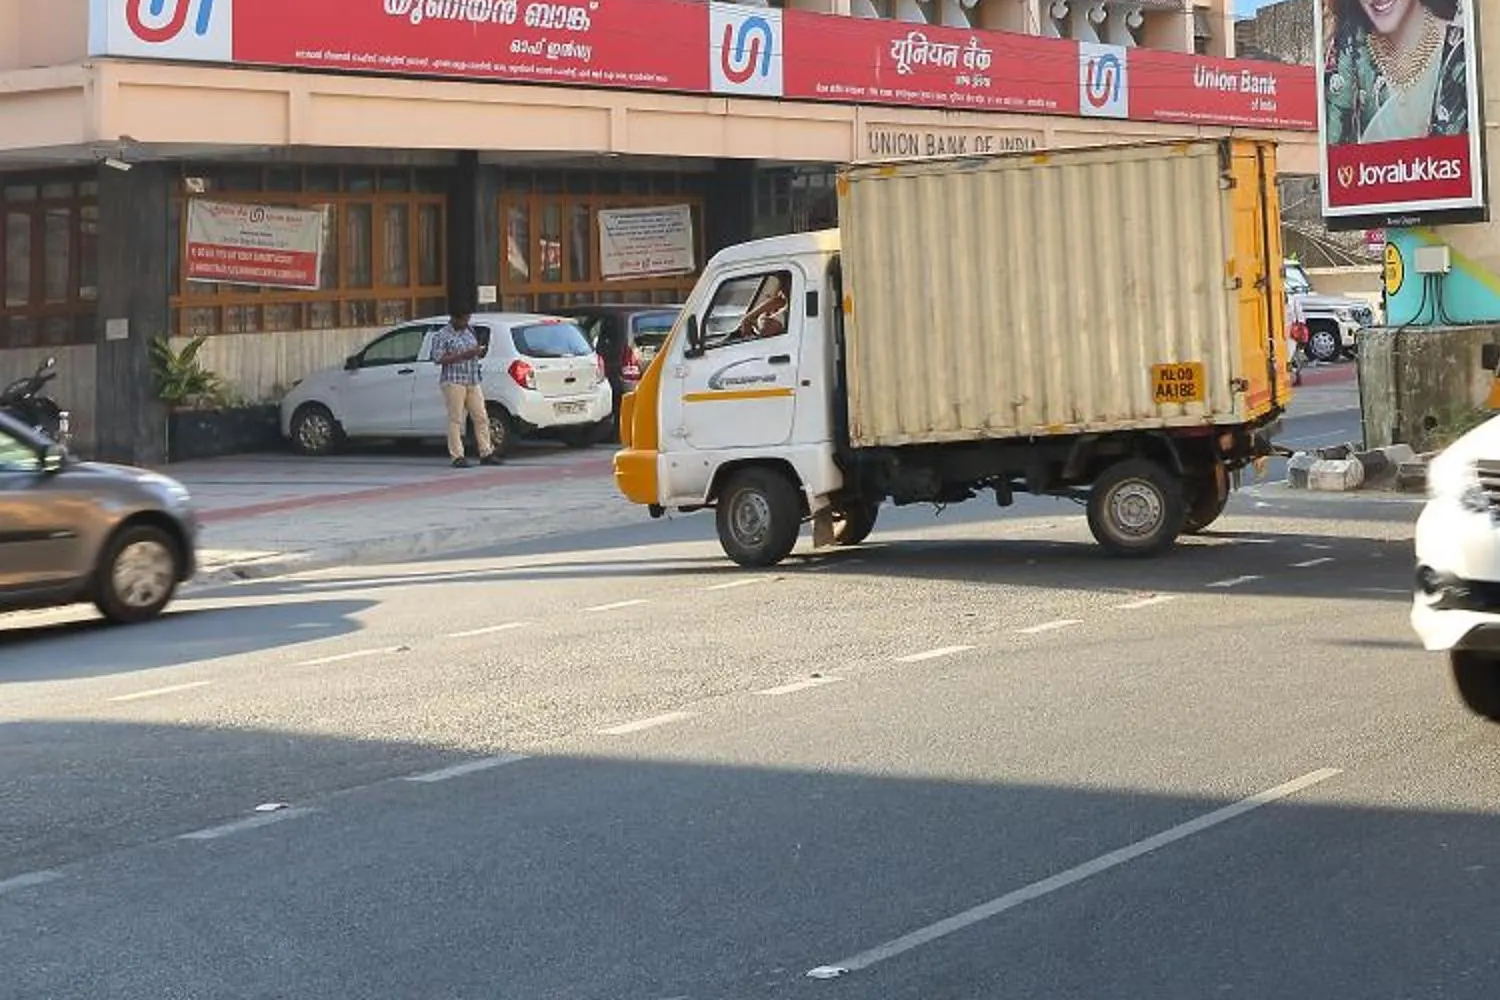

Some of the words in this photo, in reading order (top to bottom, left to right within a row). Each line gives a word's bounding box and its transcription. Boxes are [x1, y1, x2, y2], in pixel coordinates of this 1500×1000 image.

[890, 30, 960, 75] यूनियन
[1193, 63, 1237, 92] Union
[1239, 69, 1277, 96] Bank
[868, 131, 919, 156] UNION
[925, 133, 967, 156] BANK
[974, 135, 994, 153] OF
